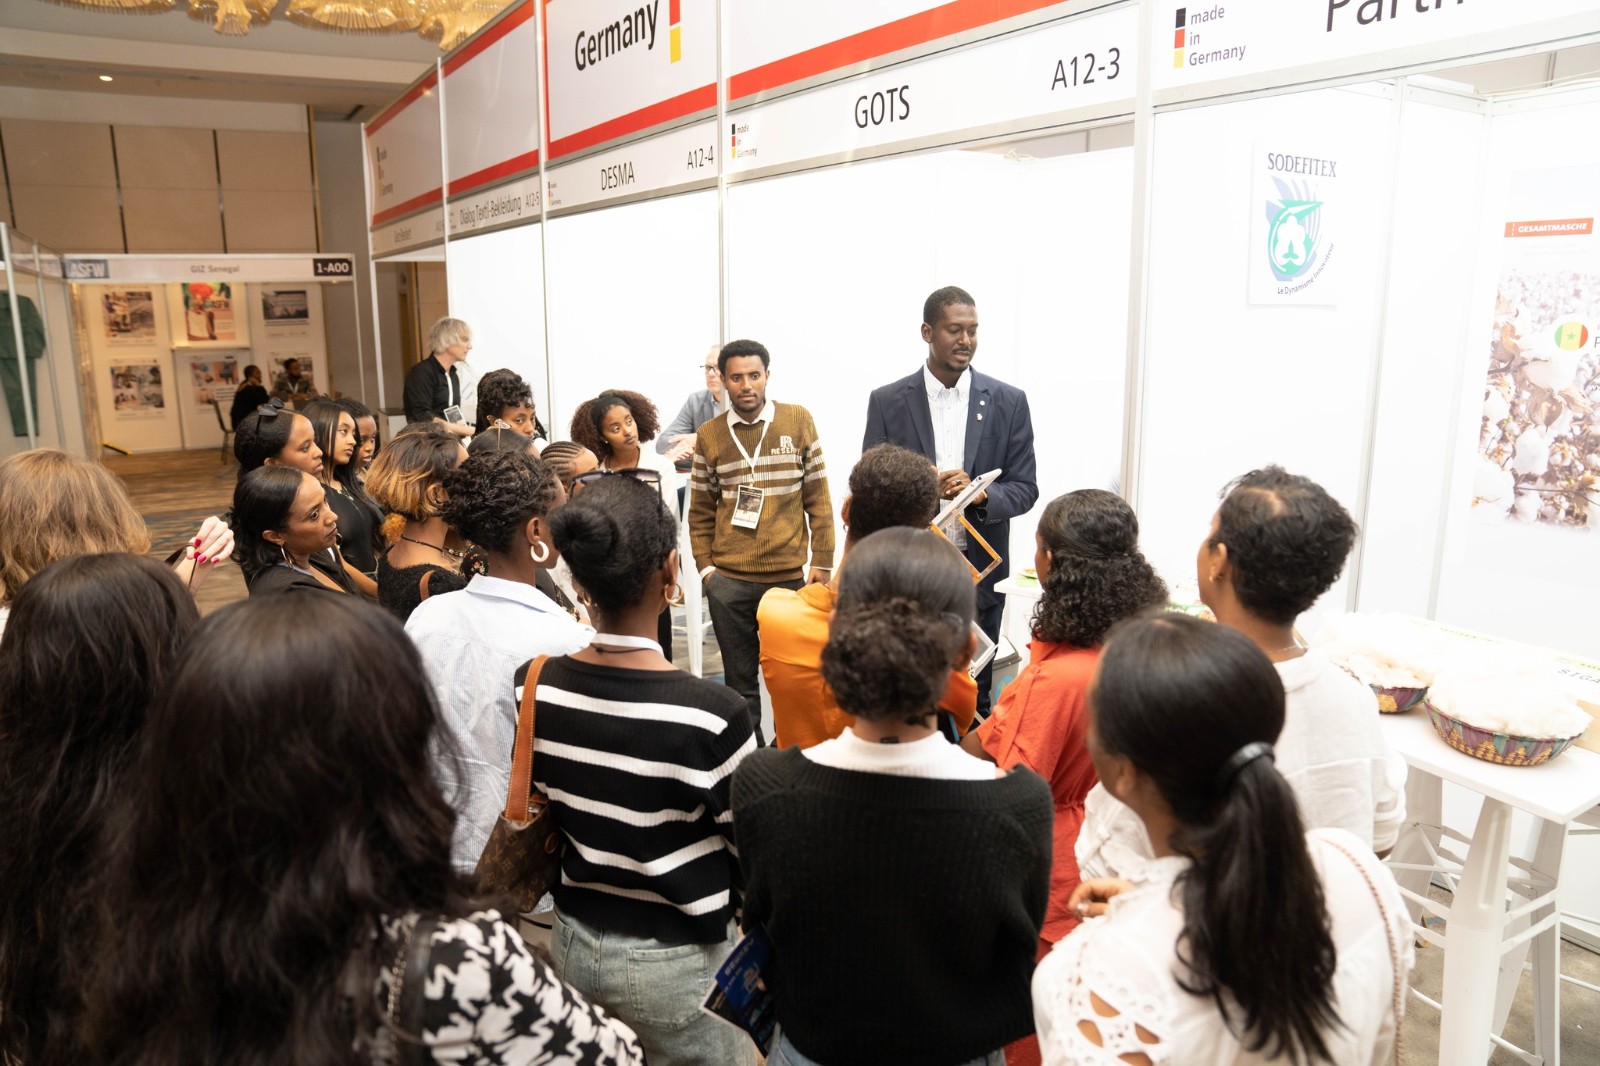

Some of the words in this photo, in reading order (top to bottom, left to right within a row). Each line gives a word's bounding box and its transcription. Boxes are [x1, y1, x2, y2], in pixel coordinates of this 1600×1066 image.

[1190, 5, 1225, 25] made
[575, 0, 658, 71] Germany
[1189, 31, 1200, 46] in
[1188, 43, 1247, 67] Germany
[1051, 47, 1121, 91] A12-3
[854, 85, 911, 129] GOTS
[687, 145, 714, 171] A12-4
[1267, 152, 1337, 178] SODEFITEX
[601, 161, 635, 191] DESMA
[525, 190, 540, 209] A12-5
[1517, 221, 1588, 233] GESAMTMASCHE
[69, 261, 105, 278] ASFW
[190, 264, 206, 274] GIZ
[208, 264, 240, 276] Senegal
[316, 261, 349, 275] 1-A00
[1277, 285, 1284, 295] Le
[1284, 276, 1314, 296] Dynamisme
[1313, 242, 1335, 280] Innovateur
